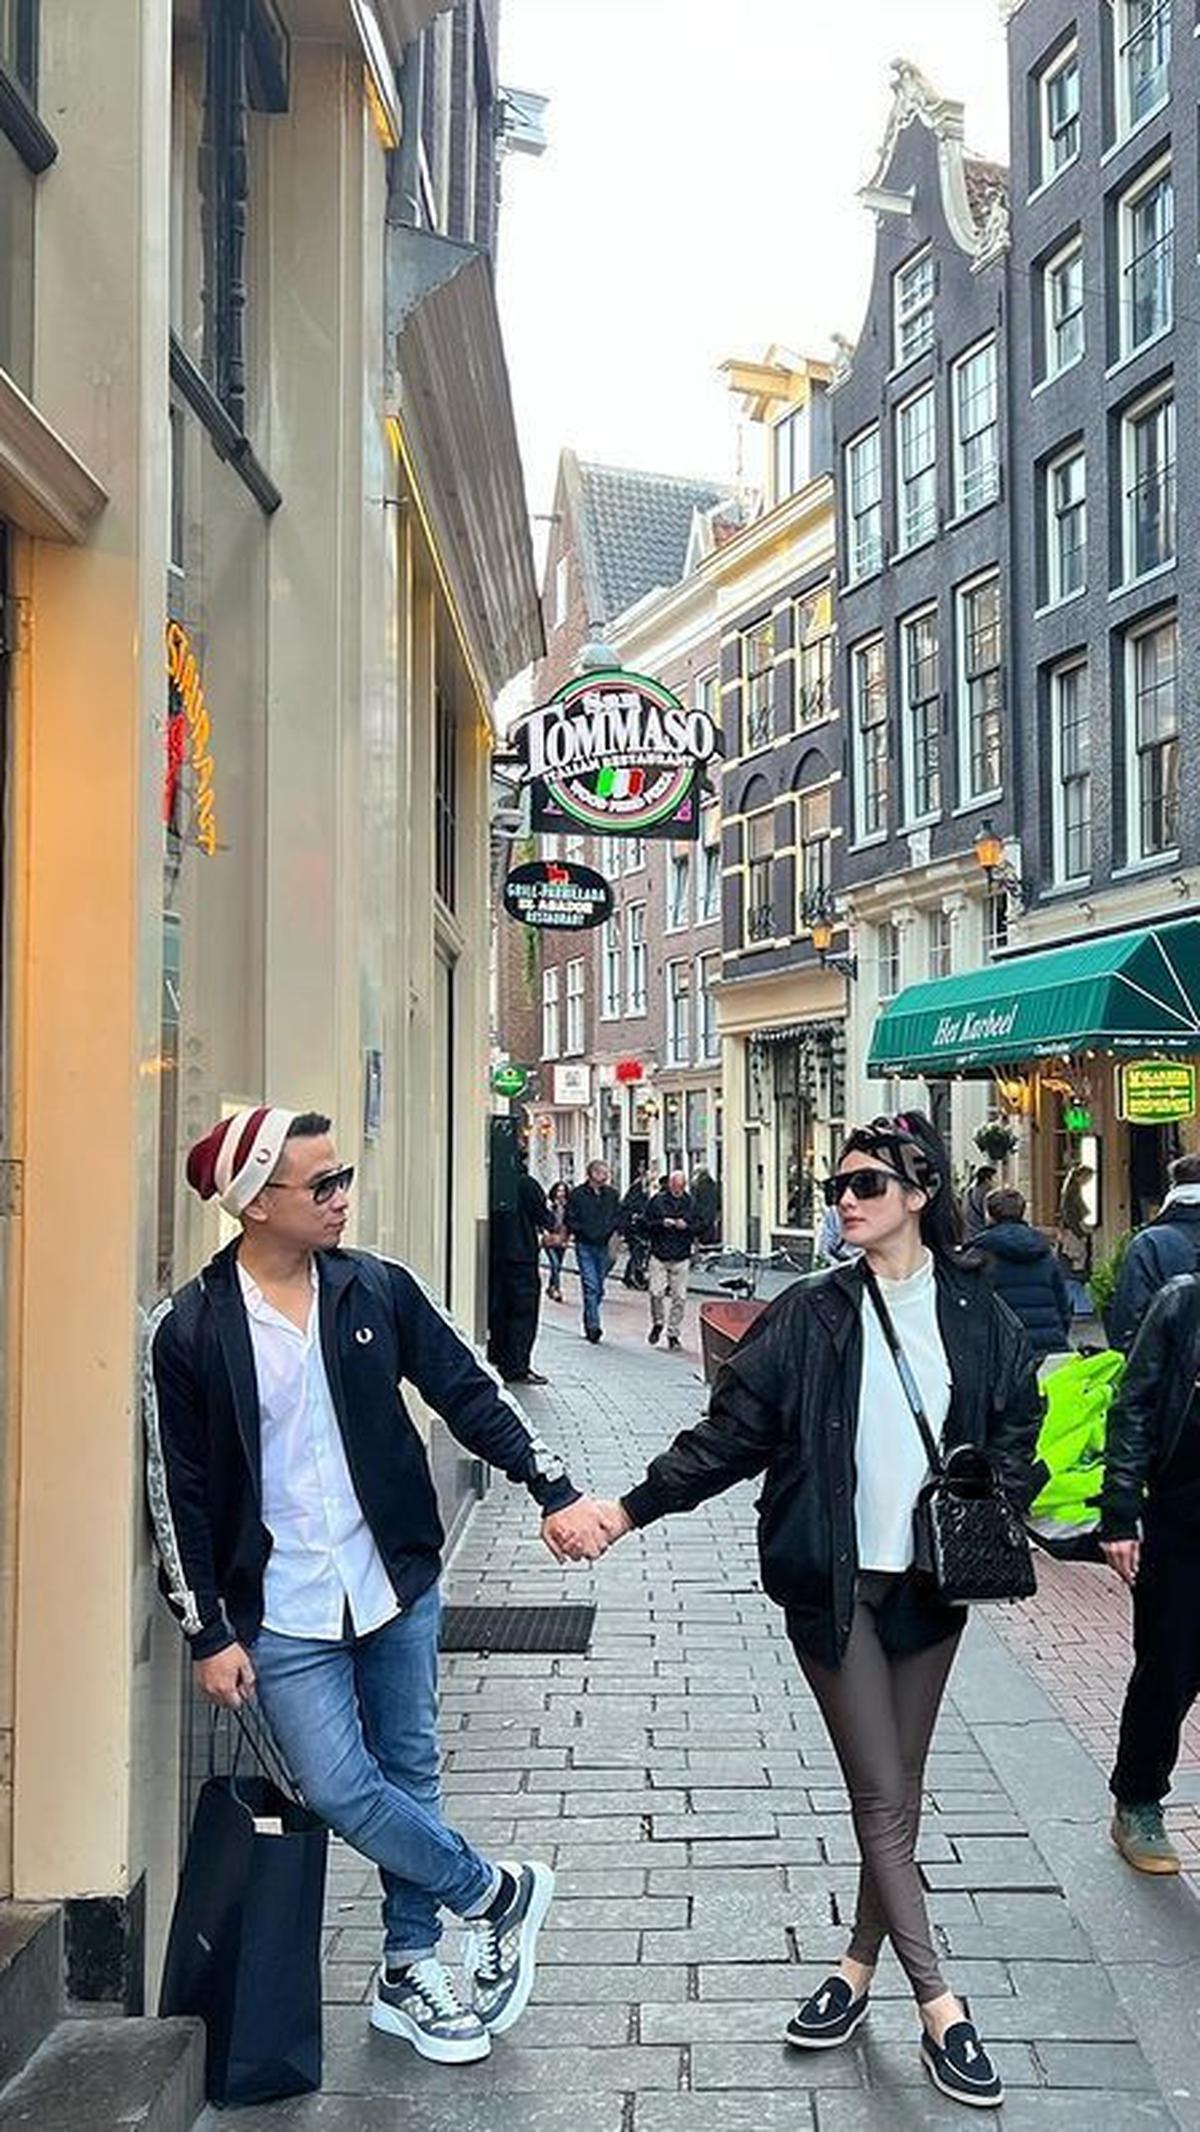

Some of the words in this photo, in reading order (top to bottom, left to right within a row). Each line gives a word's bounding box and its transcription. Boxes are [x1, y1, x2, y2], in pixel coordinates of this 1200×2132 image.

[508, 701, 714, 782] TOMMASO
[601, 749, 696, 769] RESTAURANT
[931, 1016, 962, 1046] Het
[958, 1002, 1019, 1043] Karbeel
